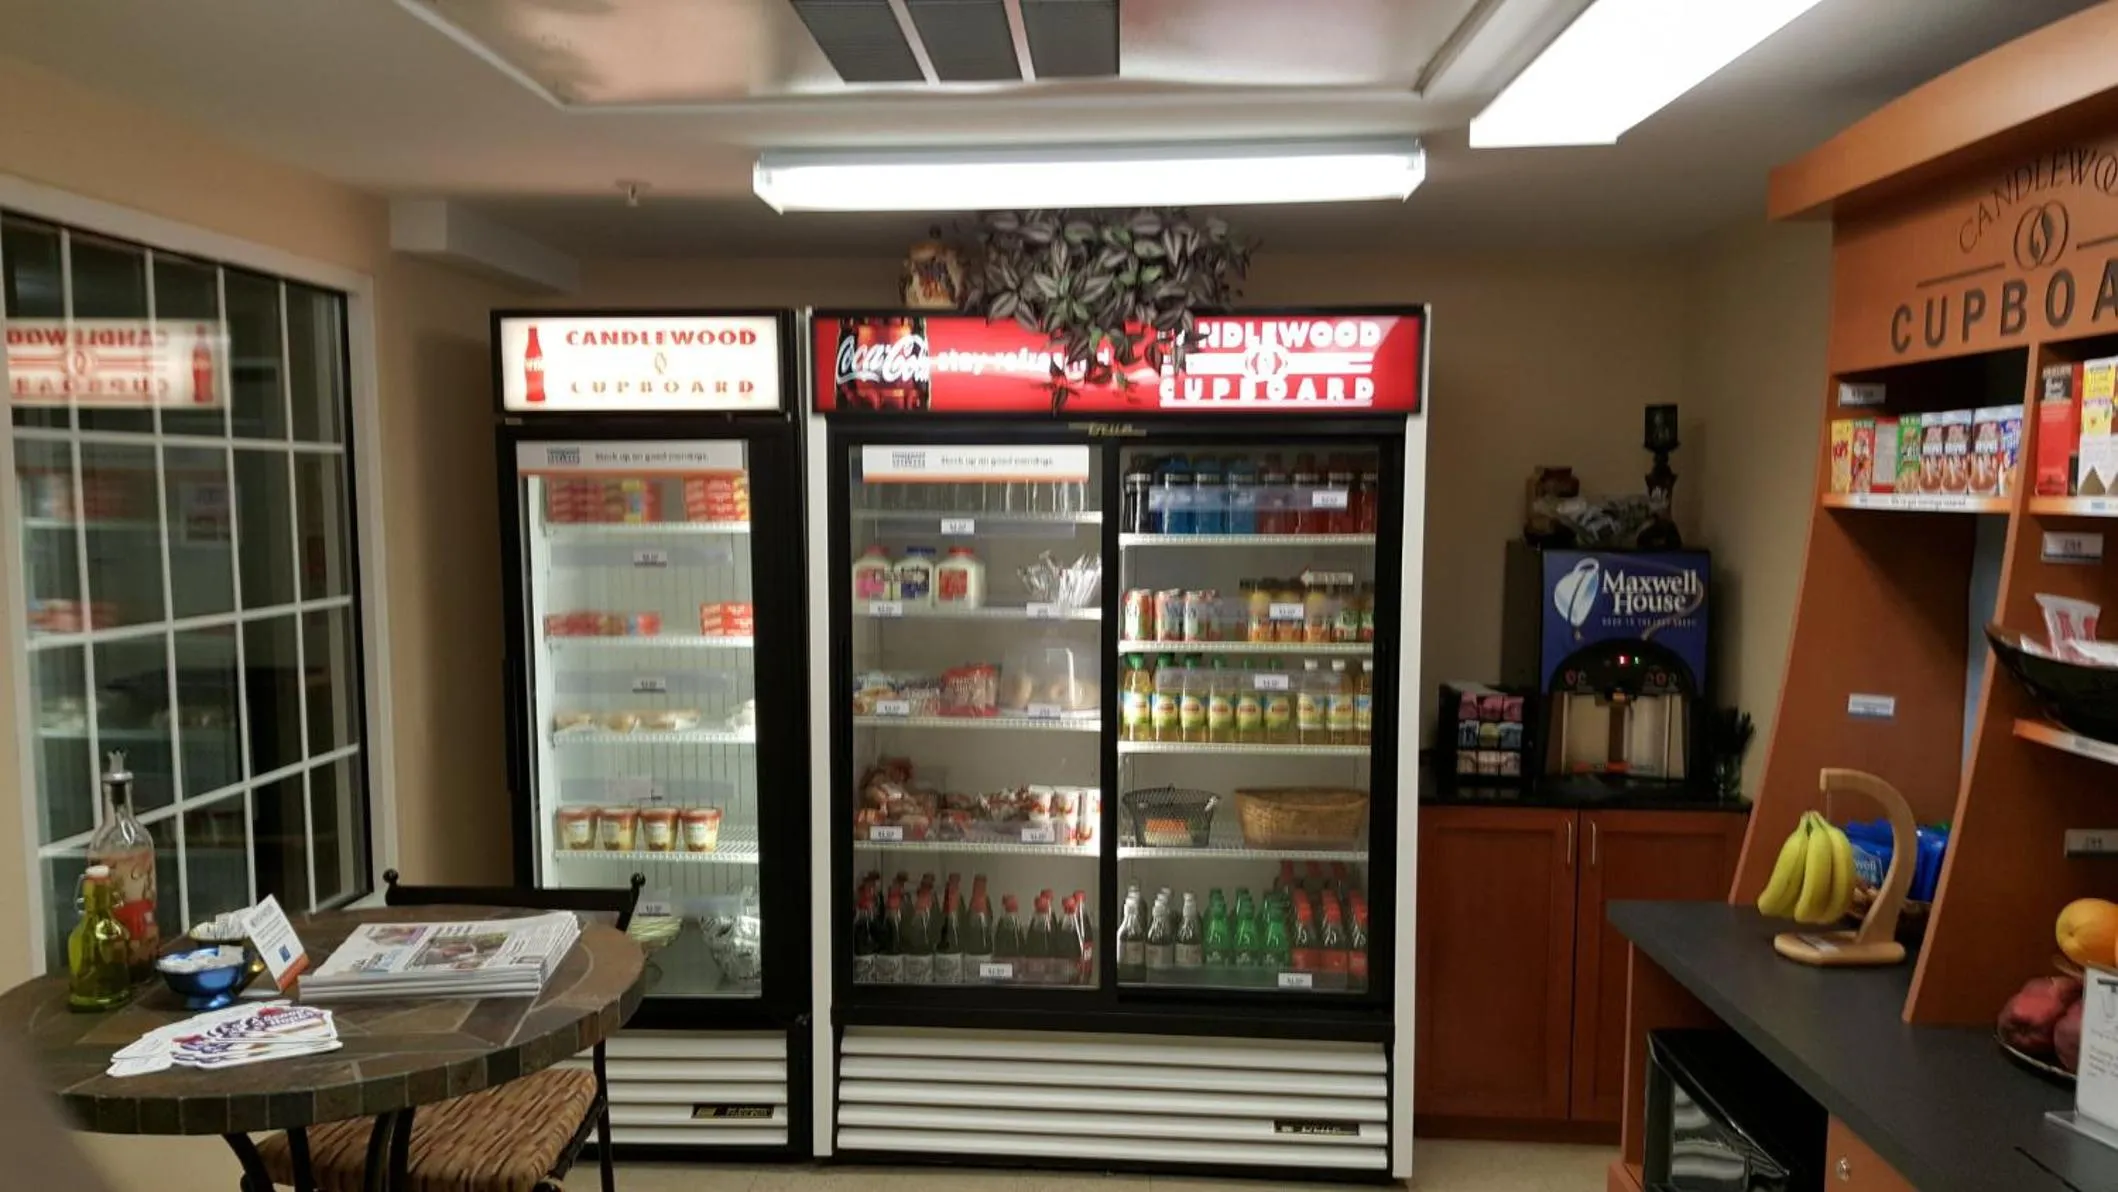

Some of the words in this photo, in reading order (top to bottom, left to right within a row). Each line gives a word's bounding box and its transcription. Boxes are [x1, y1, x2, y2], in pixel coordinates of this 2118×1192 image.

[566, 329, 757, 345] CANDLEWOOD
[1157, 321, 1381, 348] NDLEWOOD
[836, 335, 930, 384] Coca-Cola
[571, 380, 755, 394] CUPBOARD
[1159, 376, 1375, 401] CUPBOARD
[1602, 569, 1697, 595] Maxwell
[1612, 592, 1687, 616] House
